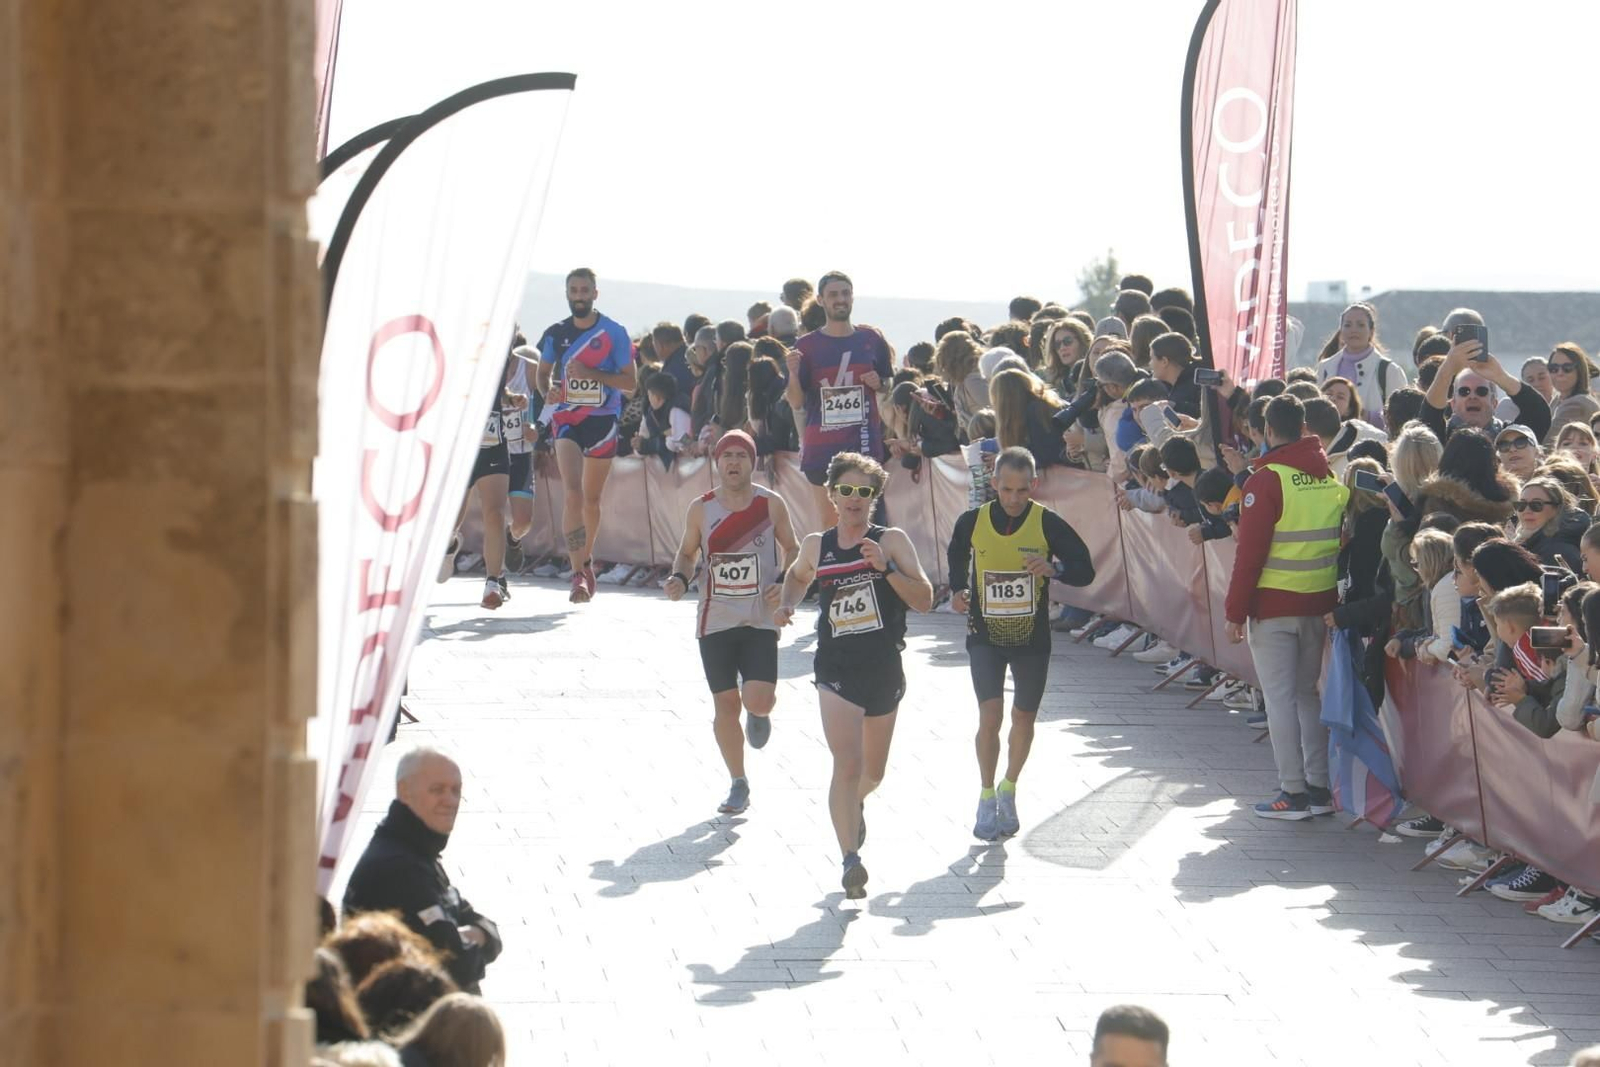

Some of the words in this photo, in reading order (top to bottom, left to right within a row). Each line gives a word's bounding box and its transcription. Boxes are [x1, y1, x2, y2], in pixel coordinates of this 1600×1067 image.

[825, 397, 860, 412] 2466
[719, 566, 750, 580] 407
[991, 584, 1025, 598] 1183
[831, 597, 866, 617] 746
